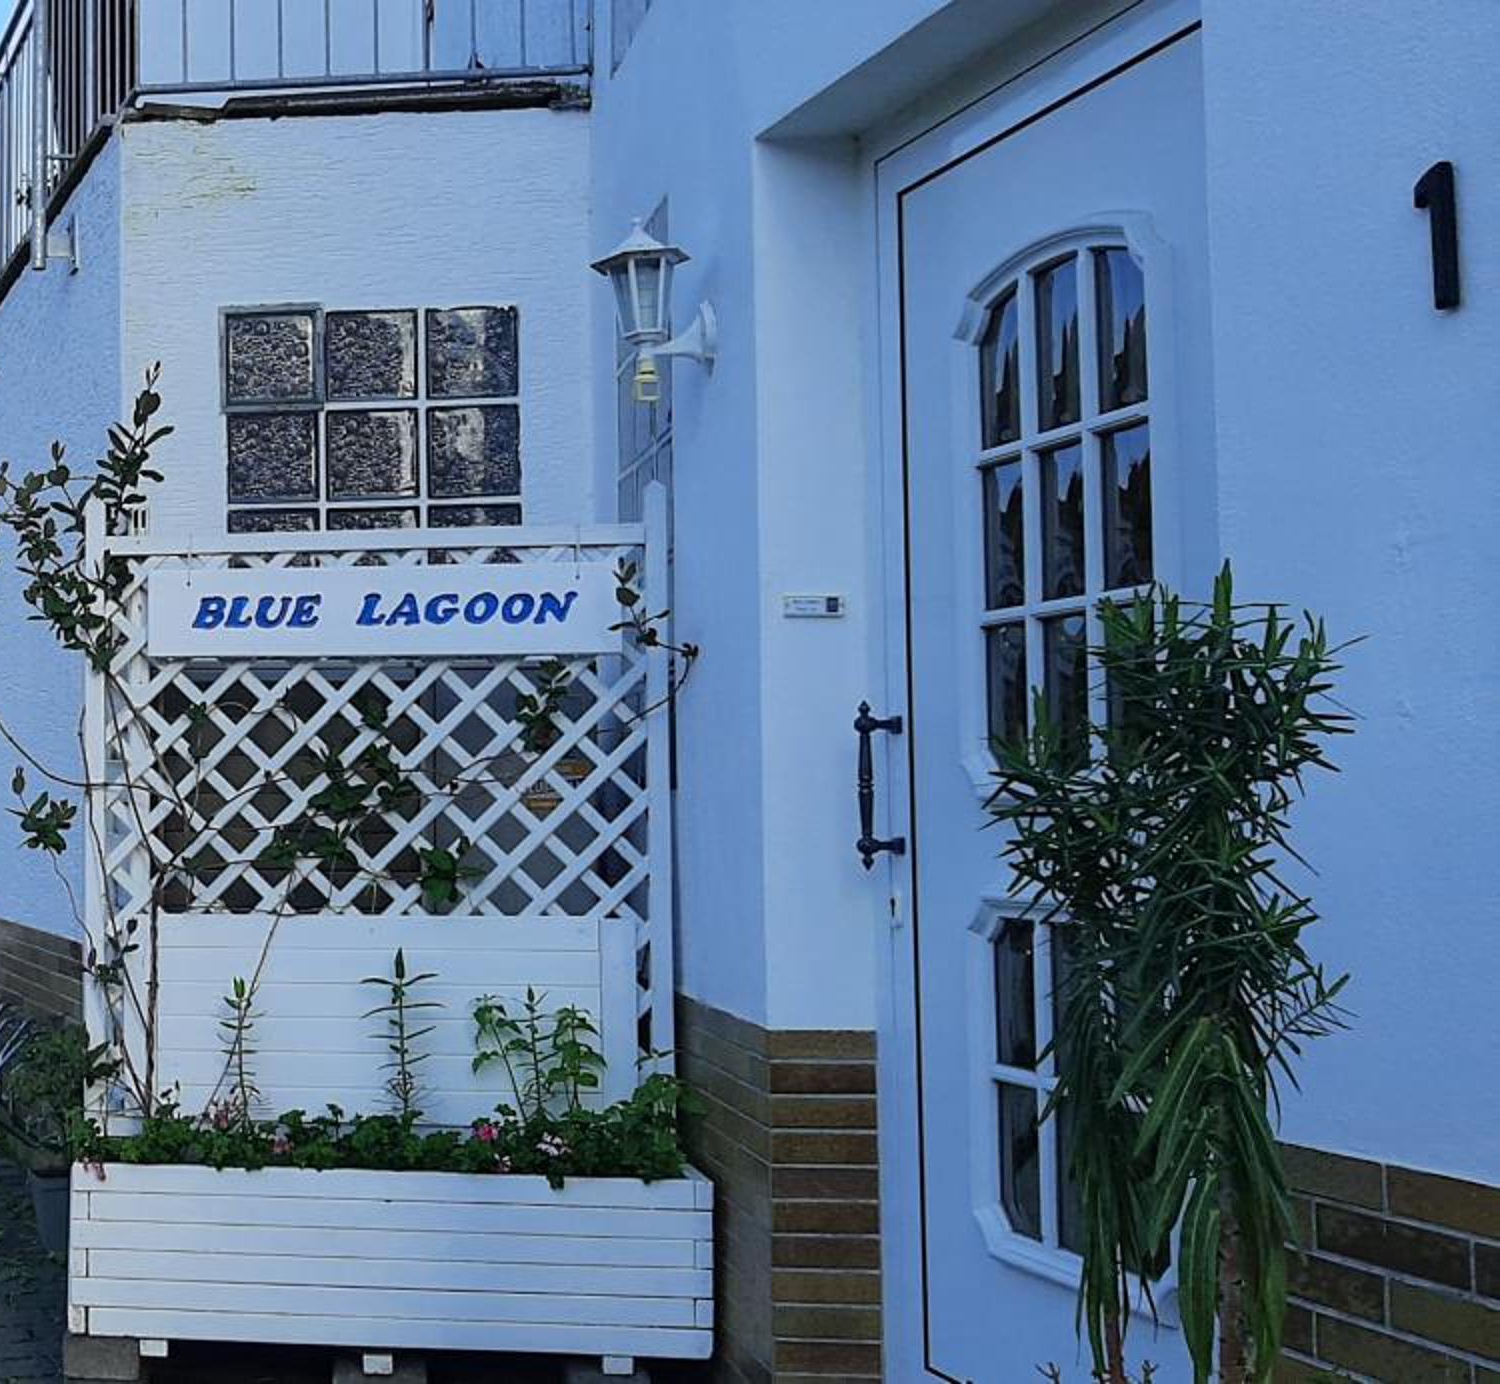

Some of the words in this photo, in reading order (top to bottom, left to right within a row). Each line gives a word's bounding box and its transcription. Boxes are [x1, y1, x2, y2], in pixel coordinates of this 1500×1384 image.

[1413, 161, 1461, 311] 1
[191, 594, 321, 629] BLUE
[355, 591, 579, 627] LAGOON
